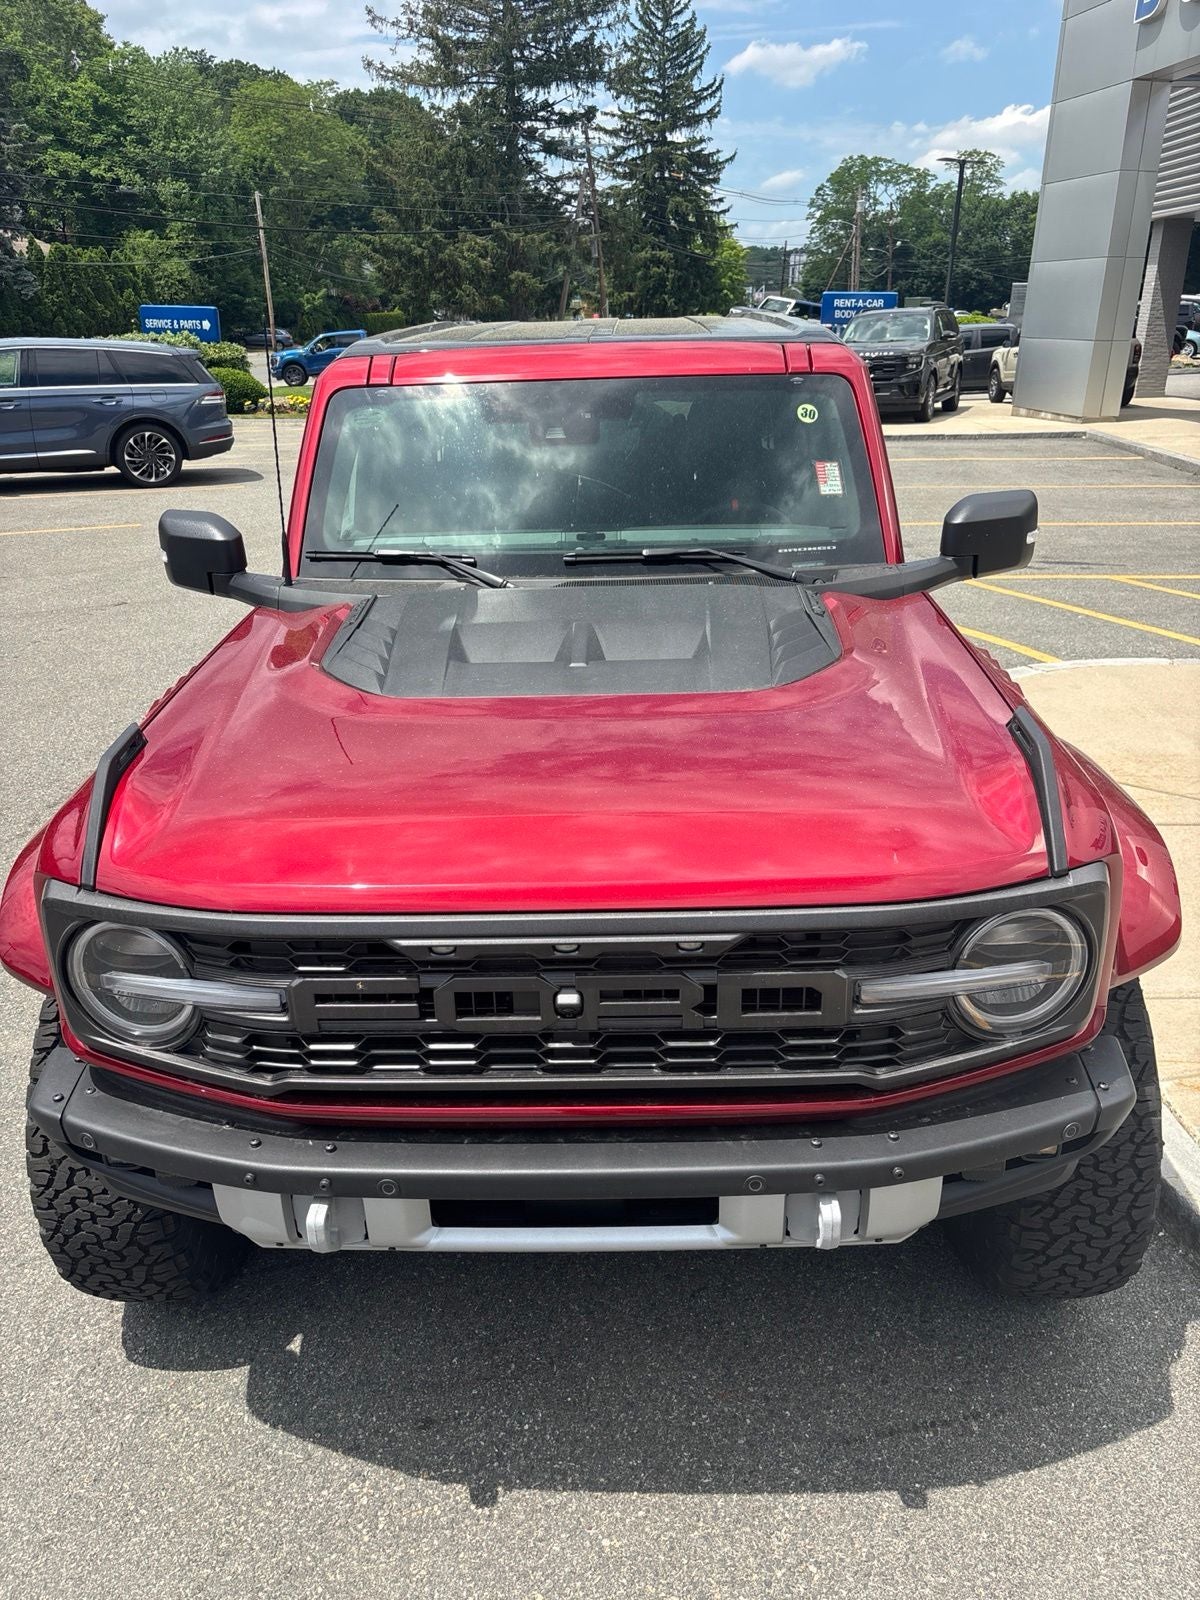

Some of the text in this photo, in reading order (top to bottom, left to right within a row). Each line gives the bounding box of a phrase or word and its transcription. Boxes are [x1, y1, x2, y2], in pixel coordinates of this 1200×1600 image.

[833, 299, 884, 307] RENT-A-CAR
[834, 310, 857, 318] BODY
[145, 318, 201, 329] SERVICE & PARTS
[801, 406, 816, 420] 30
[290, 971, 849, 1032] FORD
